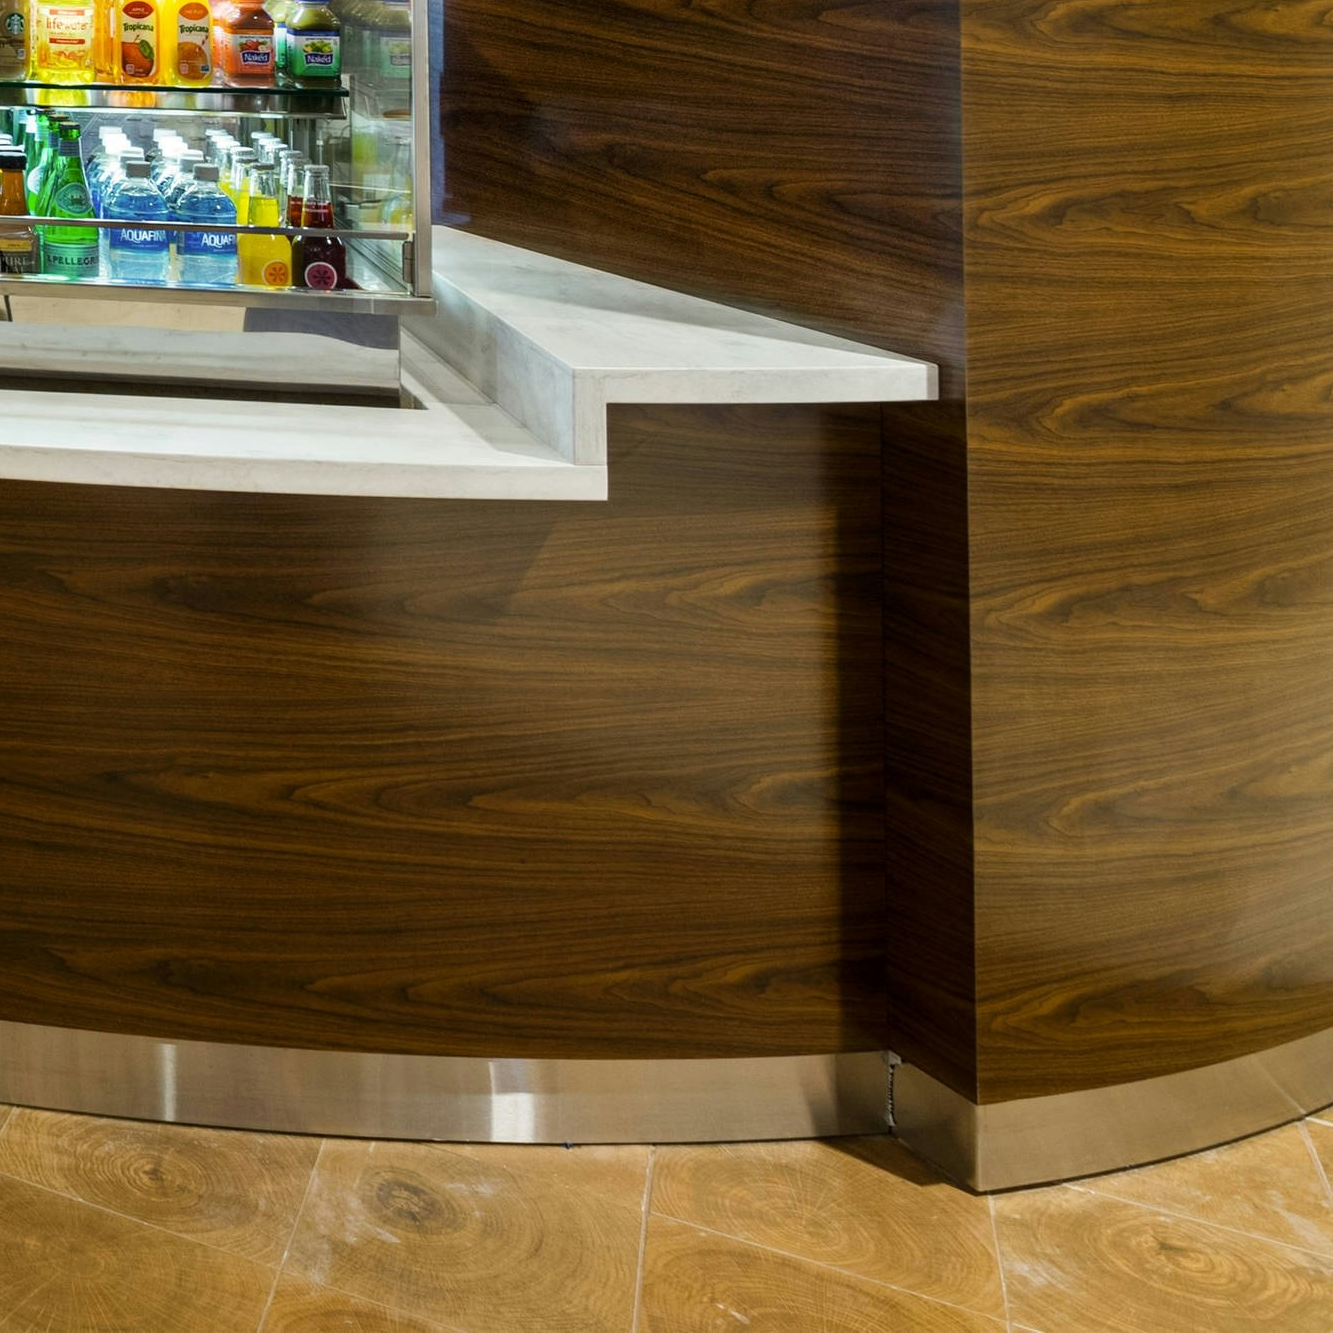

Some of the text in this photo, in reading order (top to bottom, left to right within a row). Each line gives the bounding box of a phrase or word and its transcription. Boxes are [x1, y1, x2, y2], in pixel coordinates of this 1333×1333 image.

[122, 23, 154, 33] Tropicana
[178, 24, 210, 34] Tropicana
[244, 52, 270, 63] Naked
[306, 53, 332, 64] Naked
